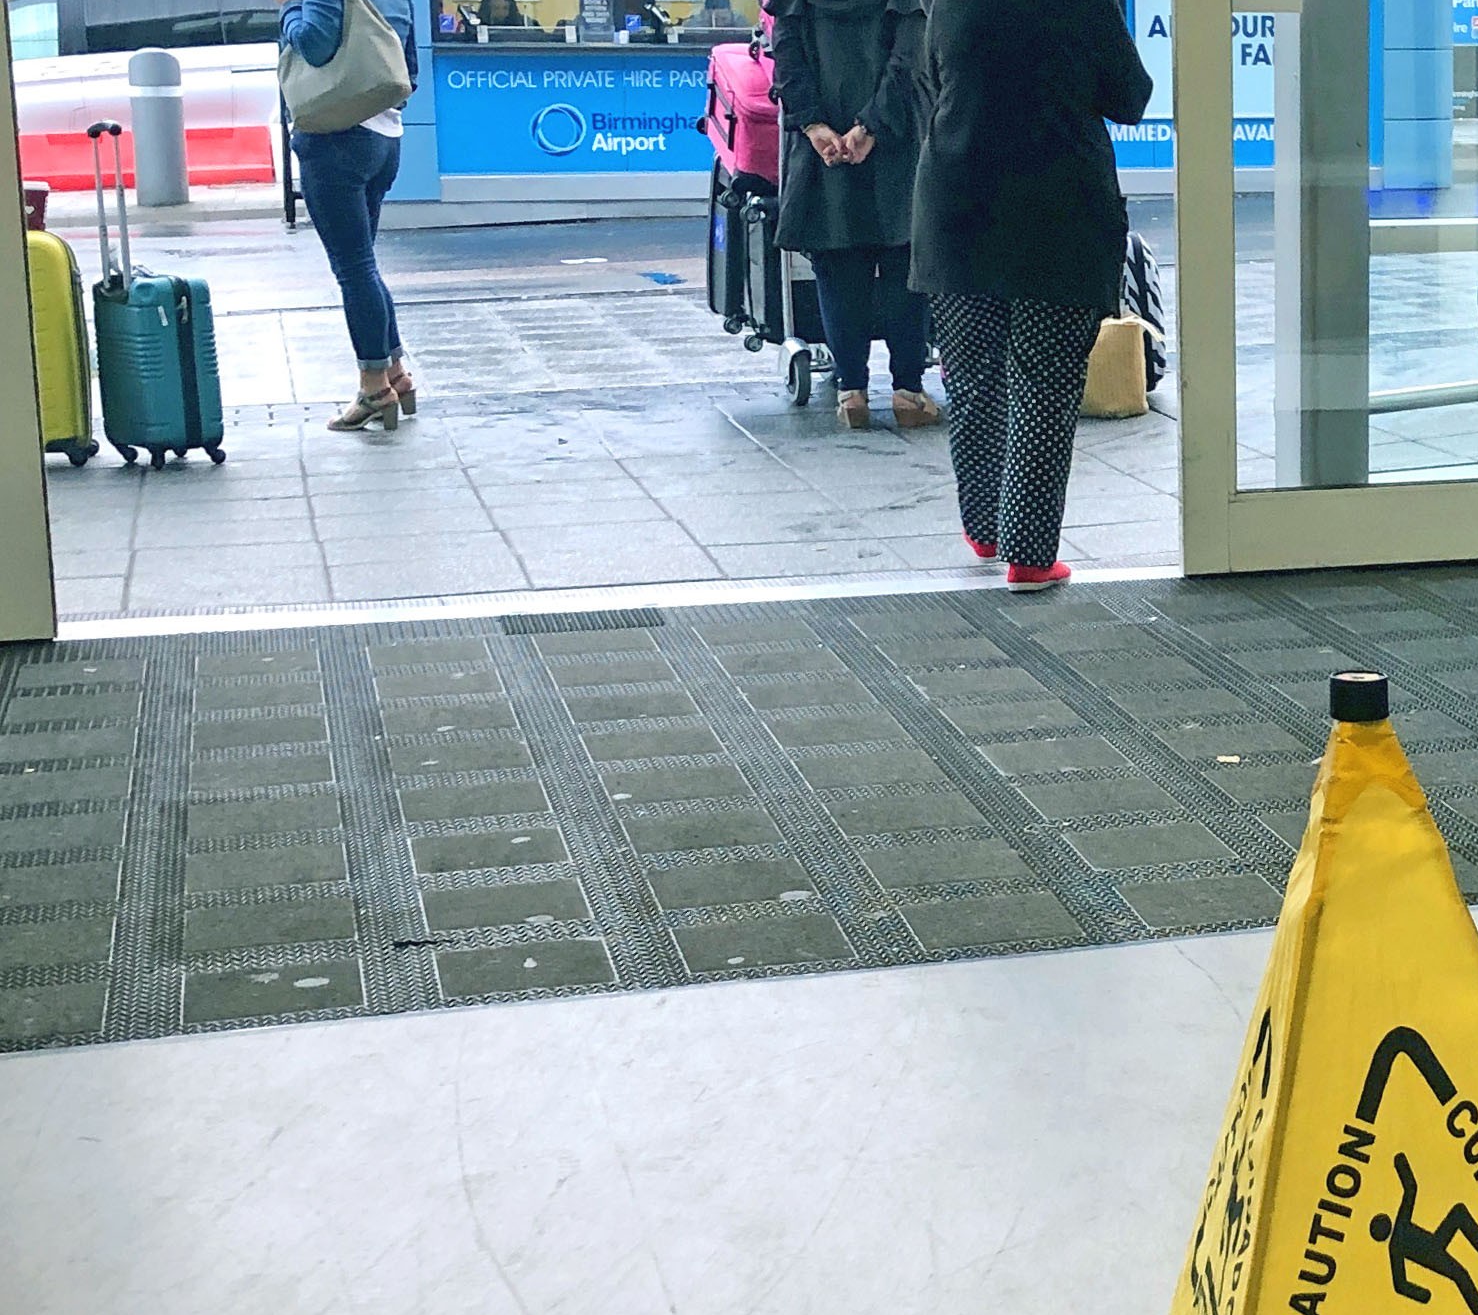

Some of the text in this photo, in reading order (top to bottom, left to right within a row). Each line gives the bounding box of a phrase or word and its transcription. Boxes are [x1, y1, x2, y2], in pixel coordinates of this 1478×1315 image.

[1241, 43, 1274, 66] FA
[447, 70, 536, 88] OFFICIAL
[543, 70, 614, 88] PRIVATE
[623, 70, 662, 88] HIRE
[592, 113, 697, 134] Birmingha
[592, 133, 666, 155] Airport
